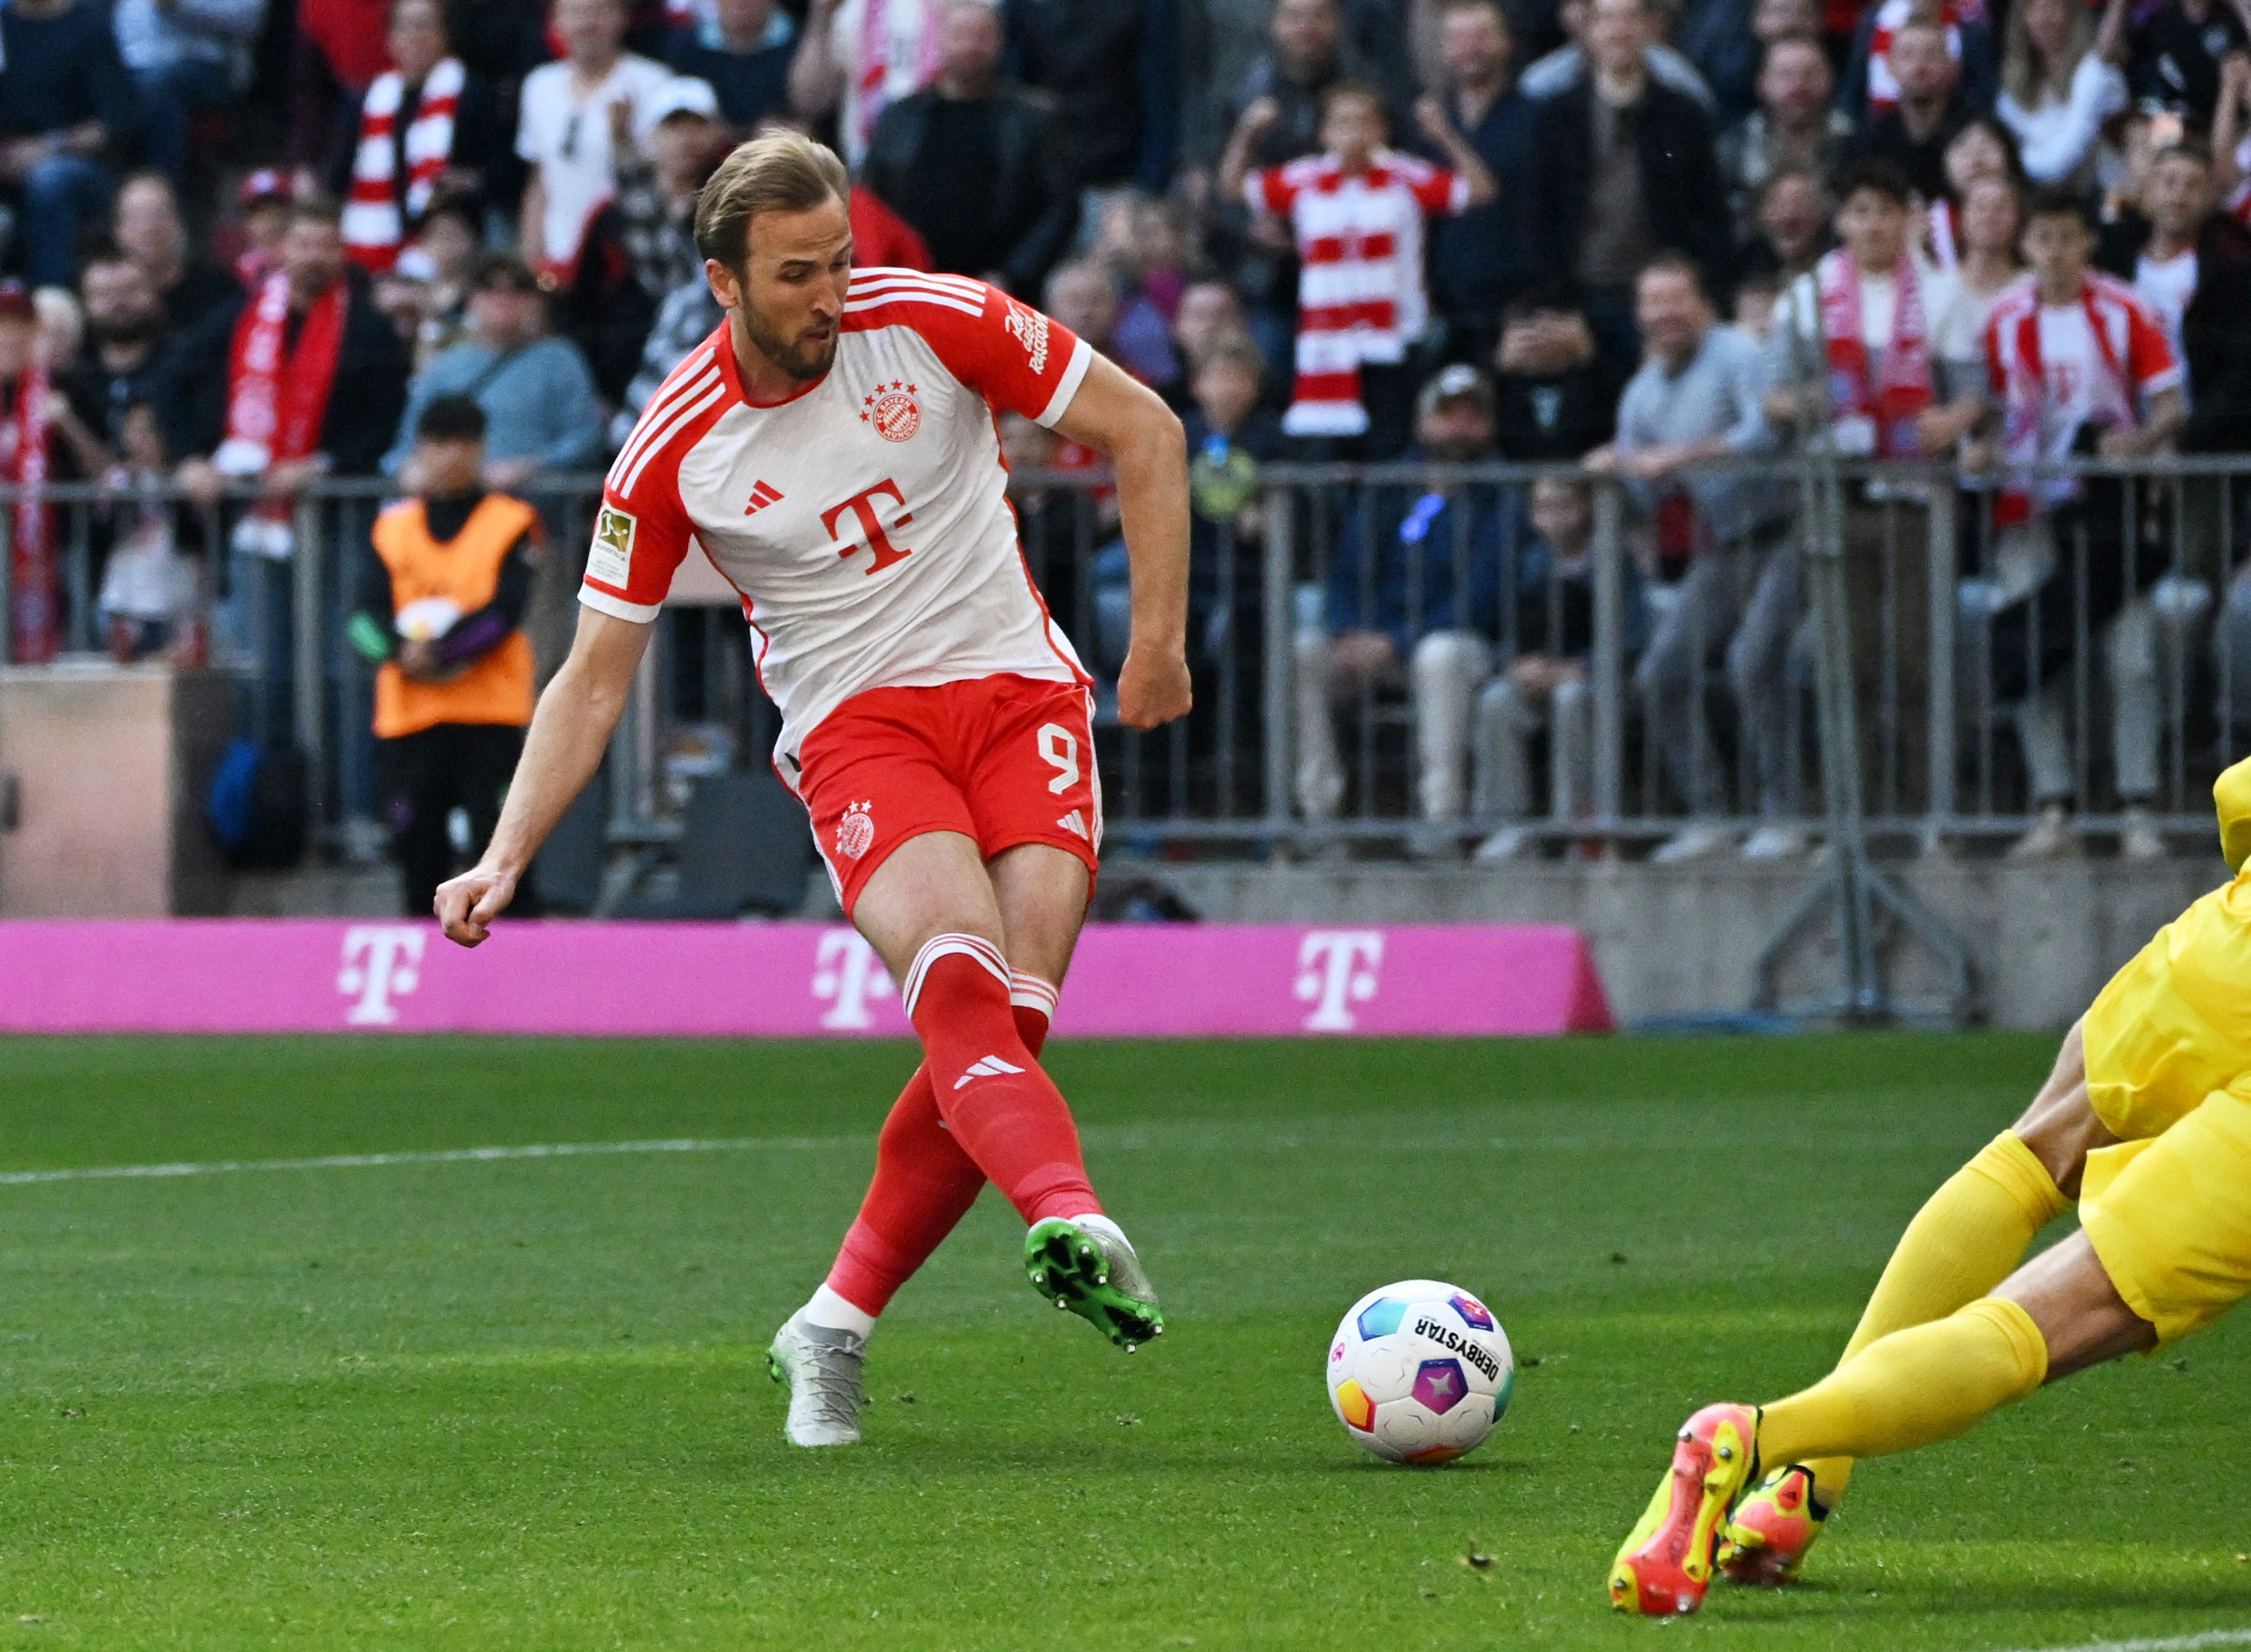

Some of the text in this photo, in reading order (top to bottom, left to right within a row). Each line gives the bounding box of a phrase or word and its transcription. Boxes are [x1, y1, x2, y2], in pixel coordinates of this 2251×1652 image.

[880, 397, 911, 410] BAYERN
[820, 477, 913, 576] T
[1036, 723, 1080, 795] 9
[339, 926, 424, 1024] T
[1295, 930, 1384, 1031] T
[1415, 1319, 1499, 1382] DERBYSTAR
